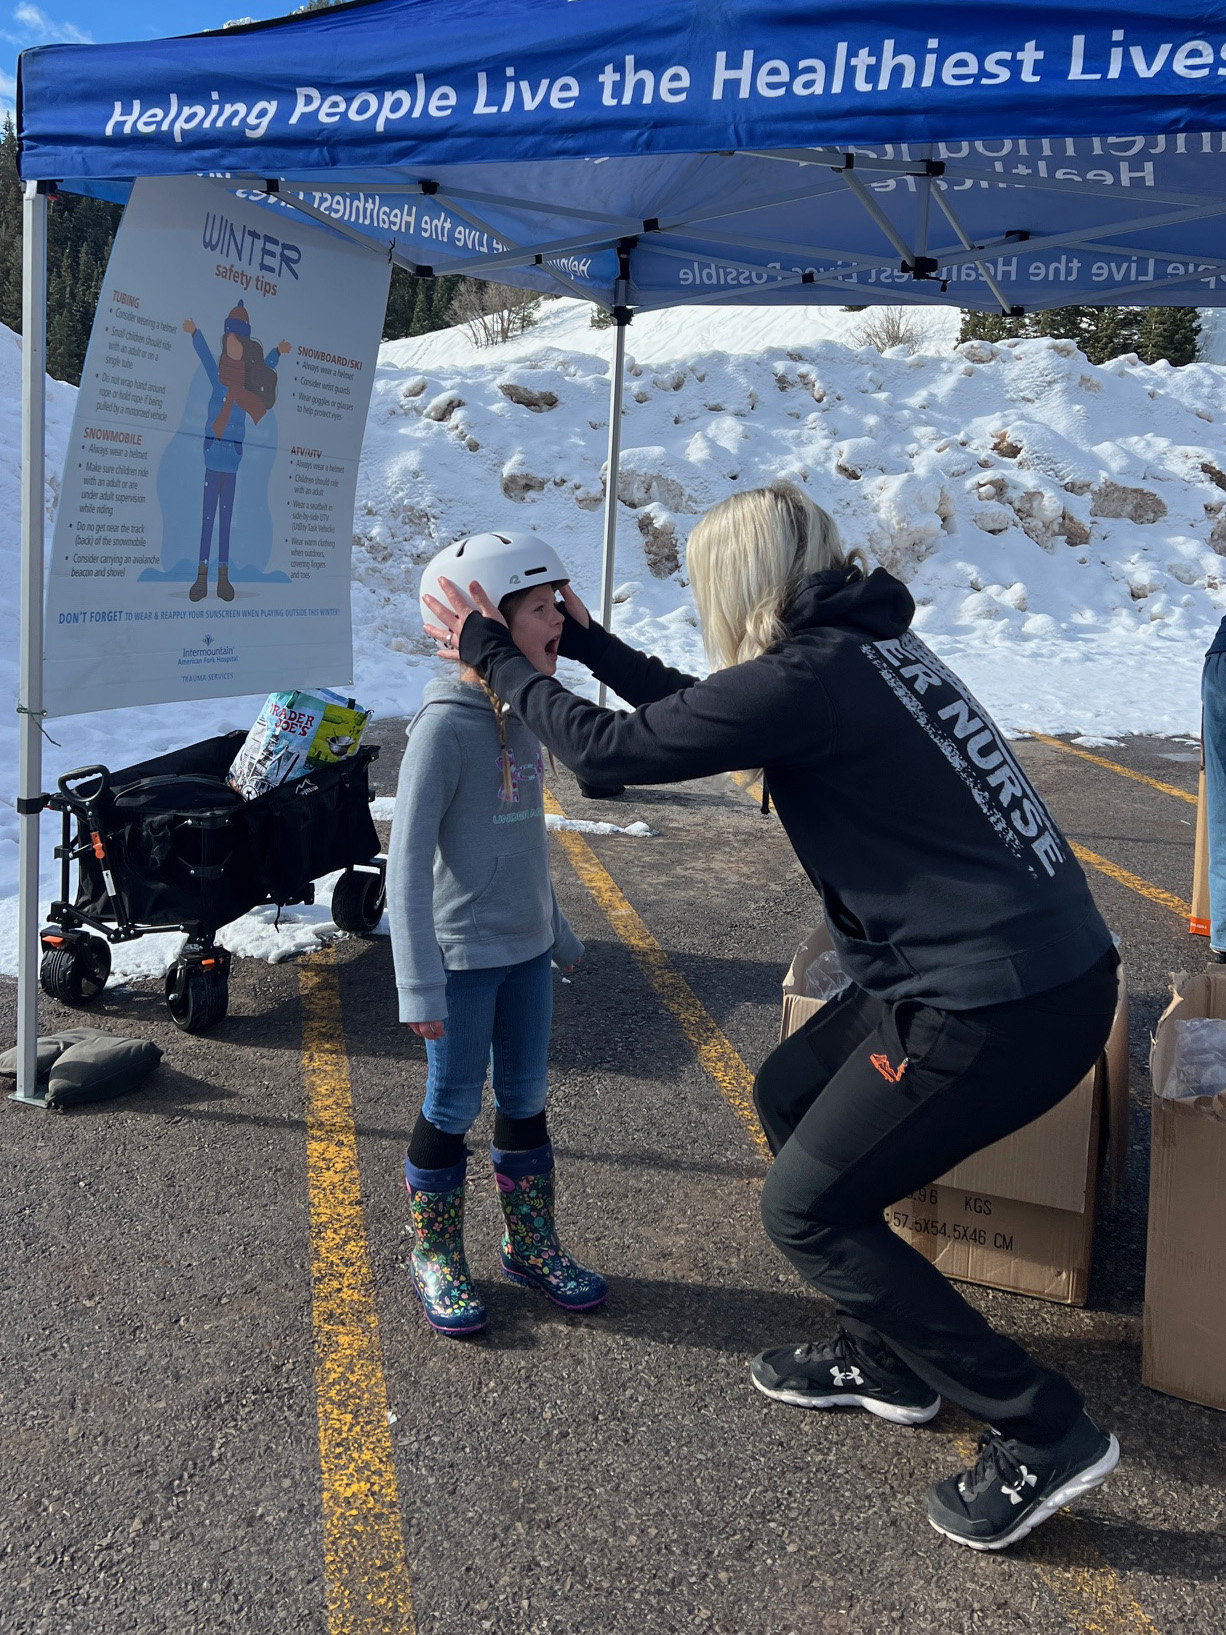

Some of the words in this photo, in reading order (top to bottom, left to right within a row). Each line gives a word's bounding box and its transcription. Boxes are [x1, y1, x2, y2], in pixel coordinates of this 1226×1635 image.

[105, 92, 276, 142] Helping
[288, 73, 456, 132] People
[473, 66, 579, 116] Live
[599, 55, 690, 107] the
[711, 37, 1044, 102] Healthiest
[203, 212, 301, 280] WINTER
[215, 264, 252, 290] safety
[255, 275, 278, 297] tips
[112, 290, 139, 308] TUBING
[297, 345, 362, 370] SNOWBOARD/SKI
[302, 361, 320, 373] Always
[320, 367, 333, 375] wear
[338, 370, 354, 380] helmet
[301, 377, 321, 388] Consider
[322, 382, 334, 391] wrist
[335, 385, 350, 395] guards
[299, 392, 311, 400] Wear
[312, 396, 330, 406] goggles
[337, 400, 354, 411] glasses
[303, 405, 313, 416] help
[314, 409, 331, 418] protect
[332, 413, 342, 421] eyes
[84, 427, 142, 445] SNOWMOBILE
[88, 444, 108, 457] Always
[109, 449, 123, 457] wear
[129, 449, 147, 460] helmet
[291, 446, 322, 459] ATV/UTV
[86, 462, 100, 472] Make
[102, 464, 115, 473] sure
[116, 464, 137, 476] children
[138, 466, 148, 477] ride
[296, 460, 312, 470] Always
[329, 465, 344, 474] helmet
[84, 476, 96, 485] with
[98, 479, 106, 487] an
[107, 478, 121, 488] adult
[295, 474, 314, 484] Children
[315, 477, 329, 486] should
[330, 479, 339, 487] ride
[81, 491, 98, 500] under
[100, 491, 114, 501] adult
[115, 493, 145, 504] supervision
[312, 488, 324, 496] adult
[80, 504, 95, 513] while
[96, 505, 113, 517] riding
[293, 500, 305, 508] Wear
[310, 502, 328, 510] seatbelt
[292, 512, 319, 521] side-by-side
[76, 522, 85, 531] Do
[96, 524, 106, 534] get
[107, 525, 120, 533] near
[121, 523, 130, 533] the
[131, 523, 144, 533] track
[292, 524, 307, 532] (Utility
[308, 524, 318, 532] Task
[318, 525, 335, 534] Vehicle)
[75, 534, 93, 546] (back)
[95, 535, 102, 545] of
[102, 536, 111, 545] the
[113, 536, 146, 547] snowmobile
[318, 540, 335, 549] clothing
[73, 553, 99, 563] Consider
[100, 555, 123, 566] carrying
[133, 555, 159, 564] avalanche
[291, 561, 310, 569] covering
[311, 561, 326, 570] fingers
[71, 567, 92, 577] beacon
[94, 567, 105, 577] and
[107, 567, 125, 577] shovel
[59, 612, 88, 624] DON'T
[90, 610, 123, 623] FORGET
[125, 612, 132, 621] TO
[134, 611, 152, 620] WEAR
[161, 610, 186, 619] REAPPLY
[188, 610, 204, 619] YOUR
[206, 610, 240, 618] SUNSCREEN
[242, 609, 259, 618] WHEN
[261, 609, 284, 618] PLAYING
[285, 608, 307, 617] OUTSIDE
[308, 608, 319, 616] THIS
[182, 647, 233, 657] Intermountain
[217, 655, 238, 663] Hospital
[208, 672, 233, 680] SERVICES
[275, 718, 310, 737] JOE'S
[872, 638, 943, 695] ER
[937, 699, 1064, 878] NURSE
[965, 1195, 992, 1215] KGS
[993, 1232, 1013, 1250] CM
